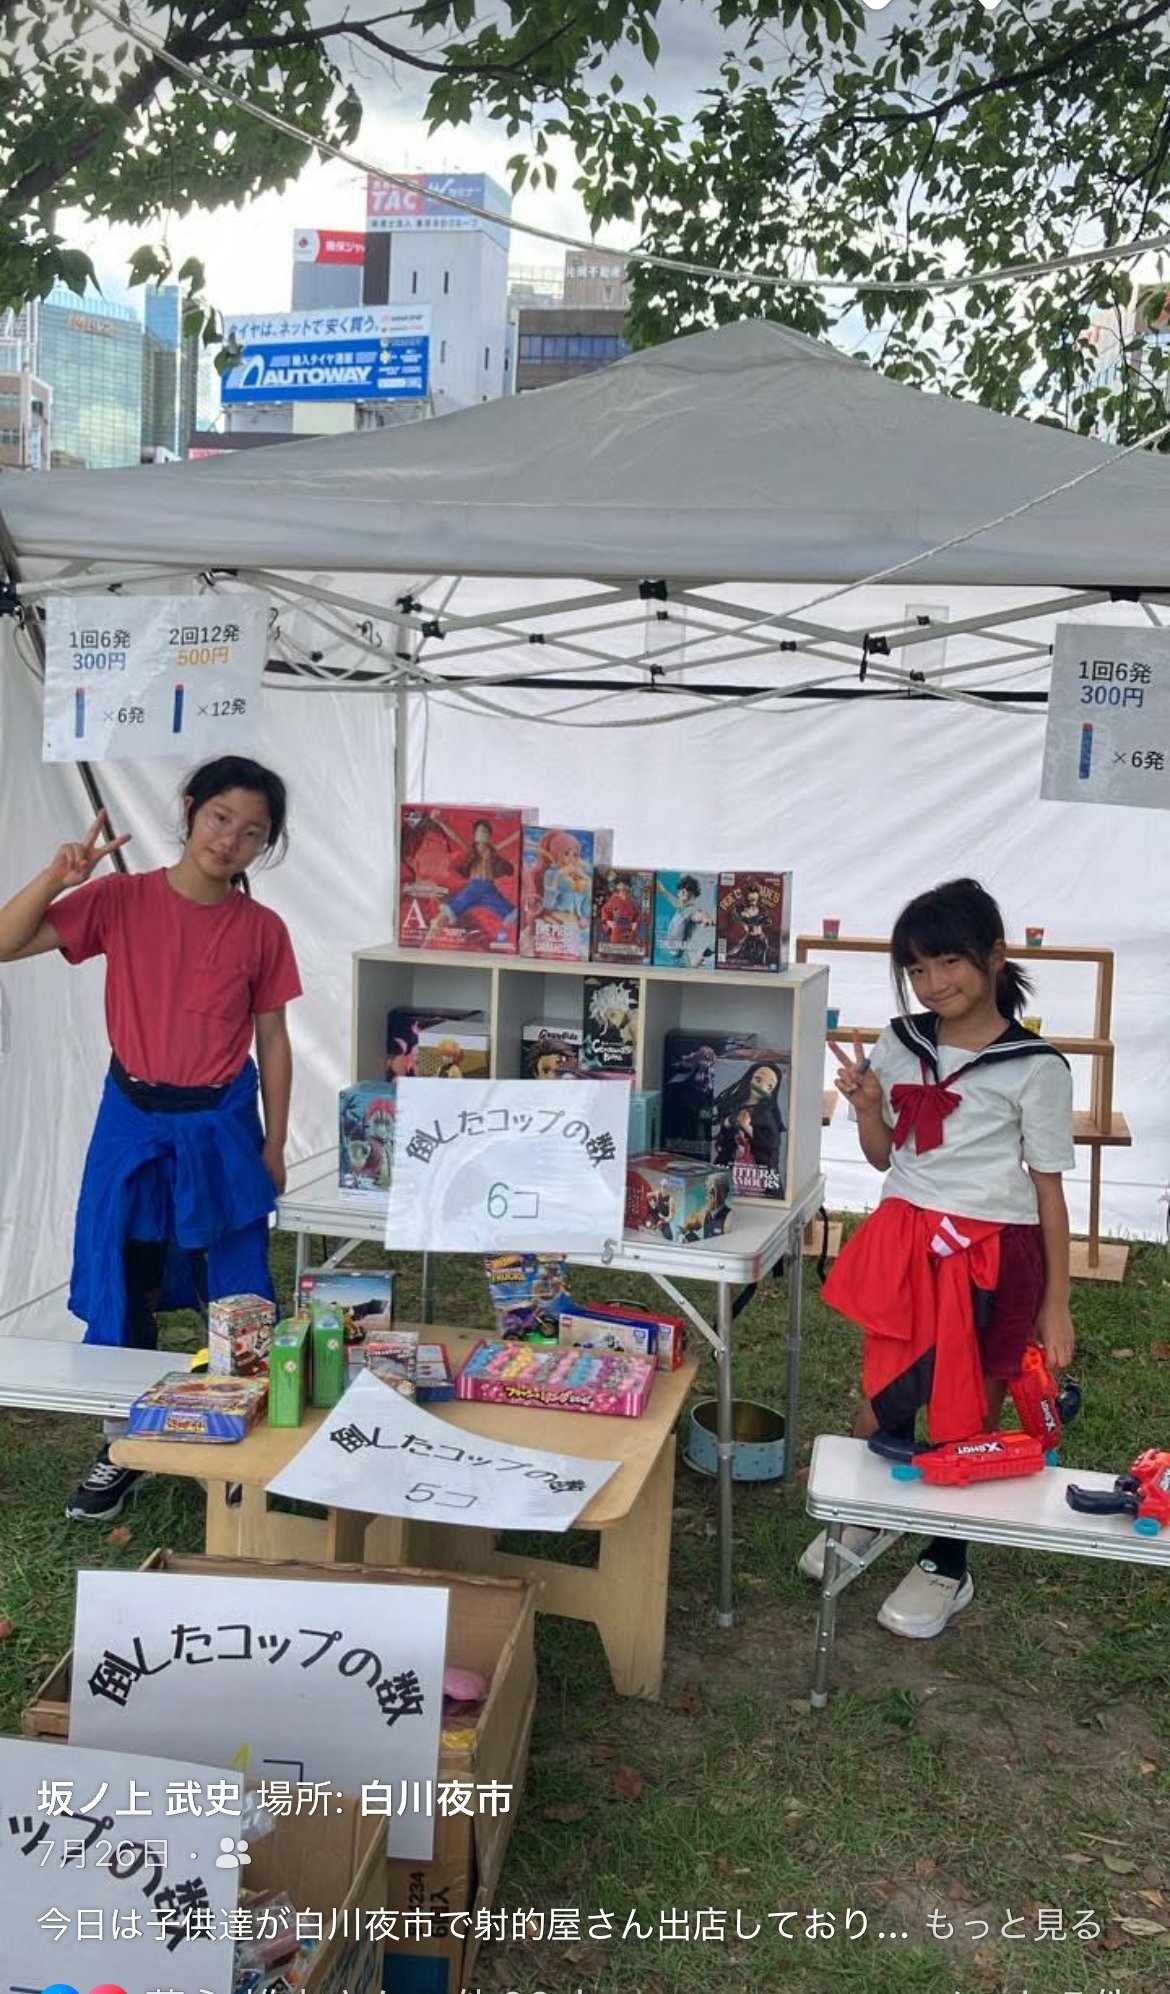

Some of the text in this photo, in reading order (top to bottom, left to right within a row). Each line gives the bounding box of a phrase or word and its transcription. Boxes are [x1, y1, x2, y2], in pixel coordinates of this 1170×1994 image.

[372, 190, 417, 212] TAC
[262, 366, 373, 386] AUTOWAY
[69, 629, 131, 650] 1回6発
[169, 624, 241, 646] 2回12発
[72, 651, 127, 671] 300円
[175, 646, 230, 666] 500円
[1078, 660, 1153, 685] 1回6発
[1080, 685, 1145, 708] 300円
[403, 898, 429, 929] A
[406, 1108, 617, 1168] 倒したコップの数
[330, 1424, 587, 1495] 倒したコップの数
[87, 1624, 425, 1727] 倒したコップの数
